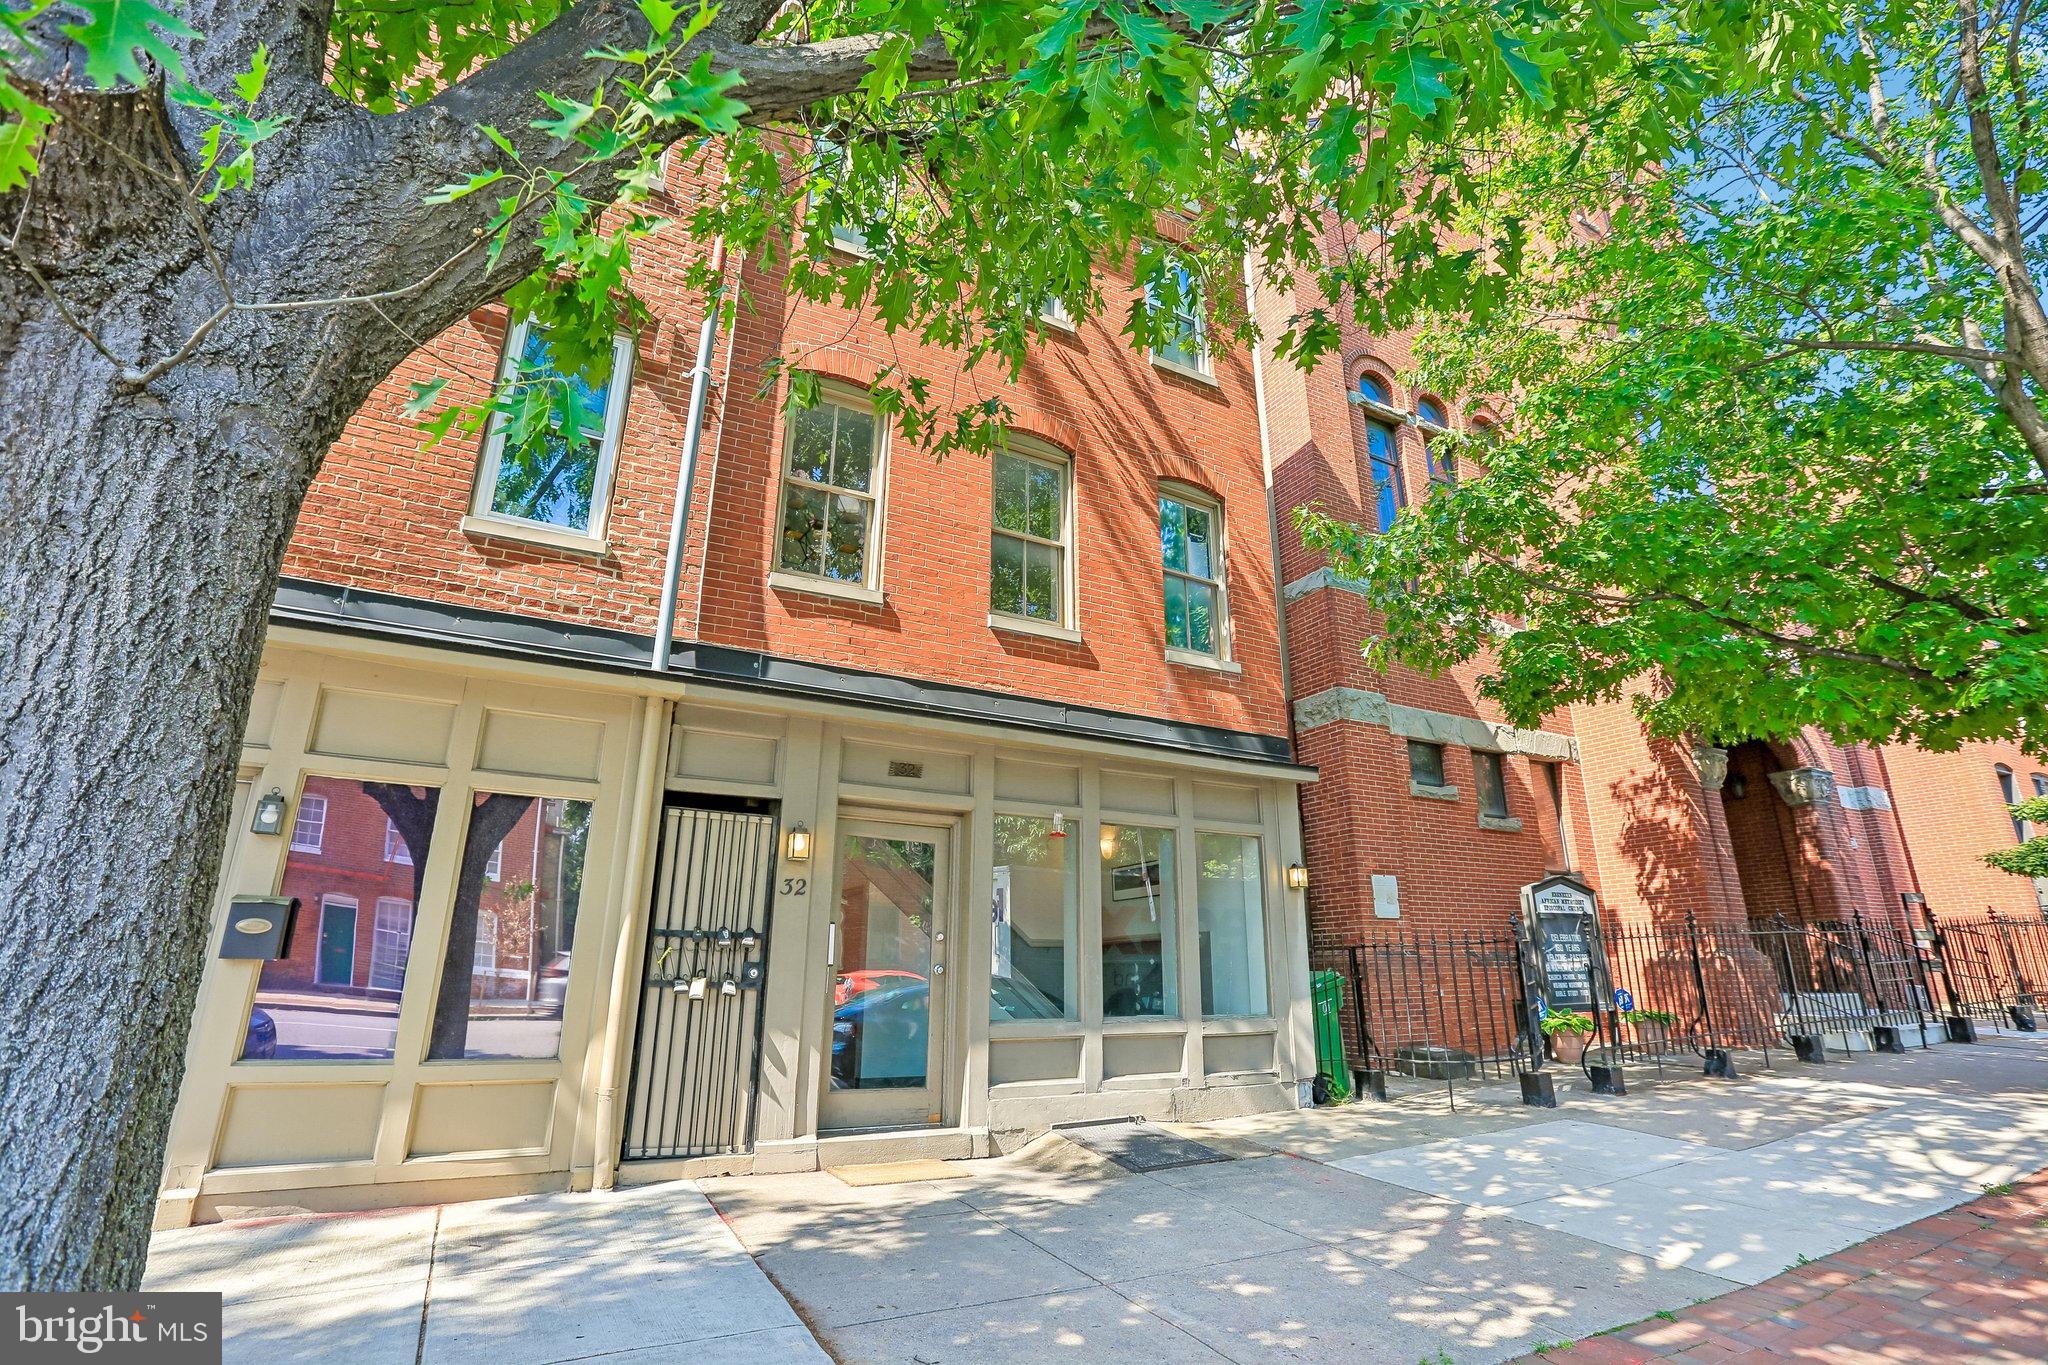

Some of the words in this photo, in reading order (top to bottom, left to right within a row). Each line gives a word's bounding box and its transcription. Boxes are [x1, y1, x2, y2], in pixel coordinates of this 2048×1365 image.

[779, 878, 807, 896] 32
[1543, 904, 1566, 912] EPISCOPAL
[1550, 933, 1582, 942] CELEBRATING
[1565, 943, 1581, 952] YEARS
